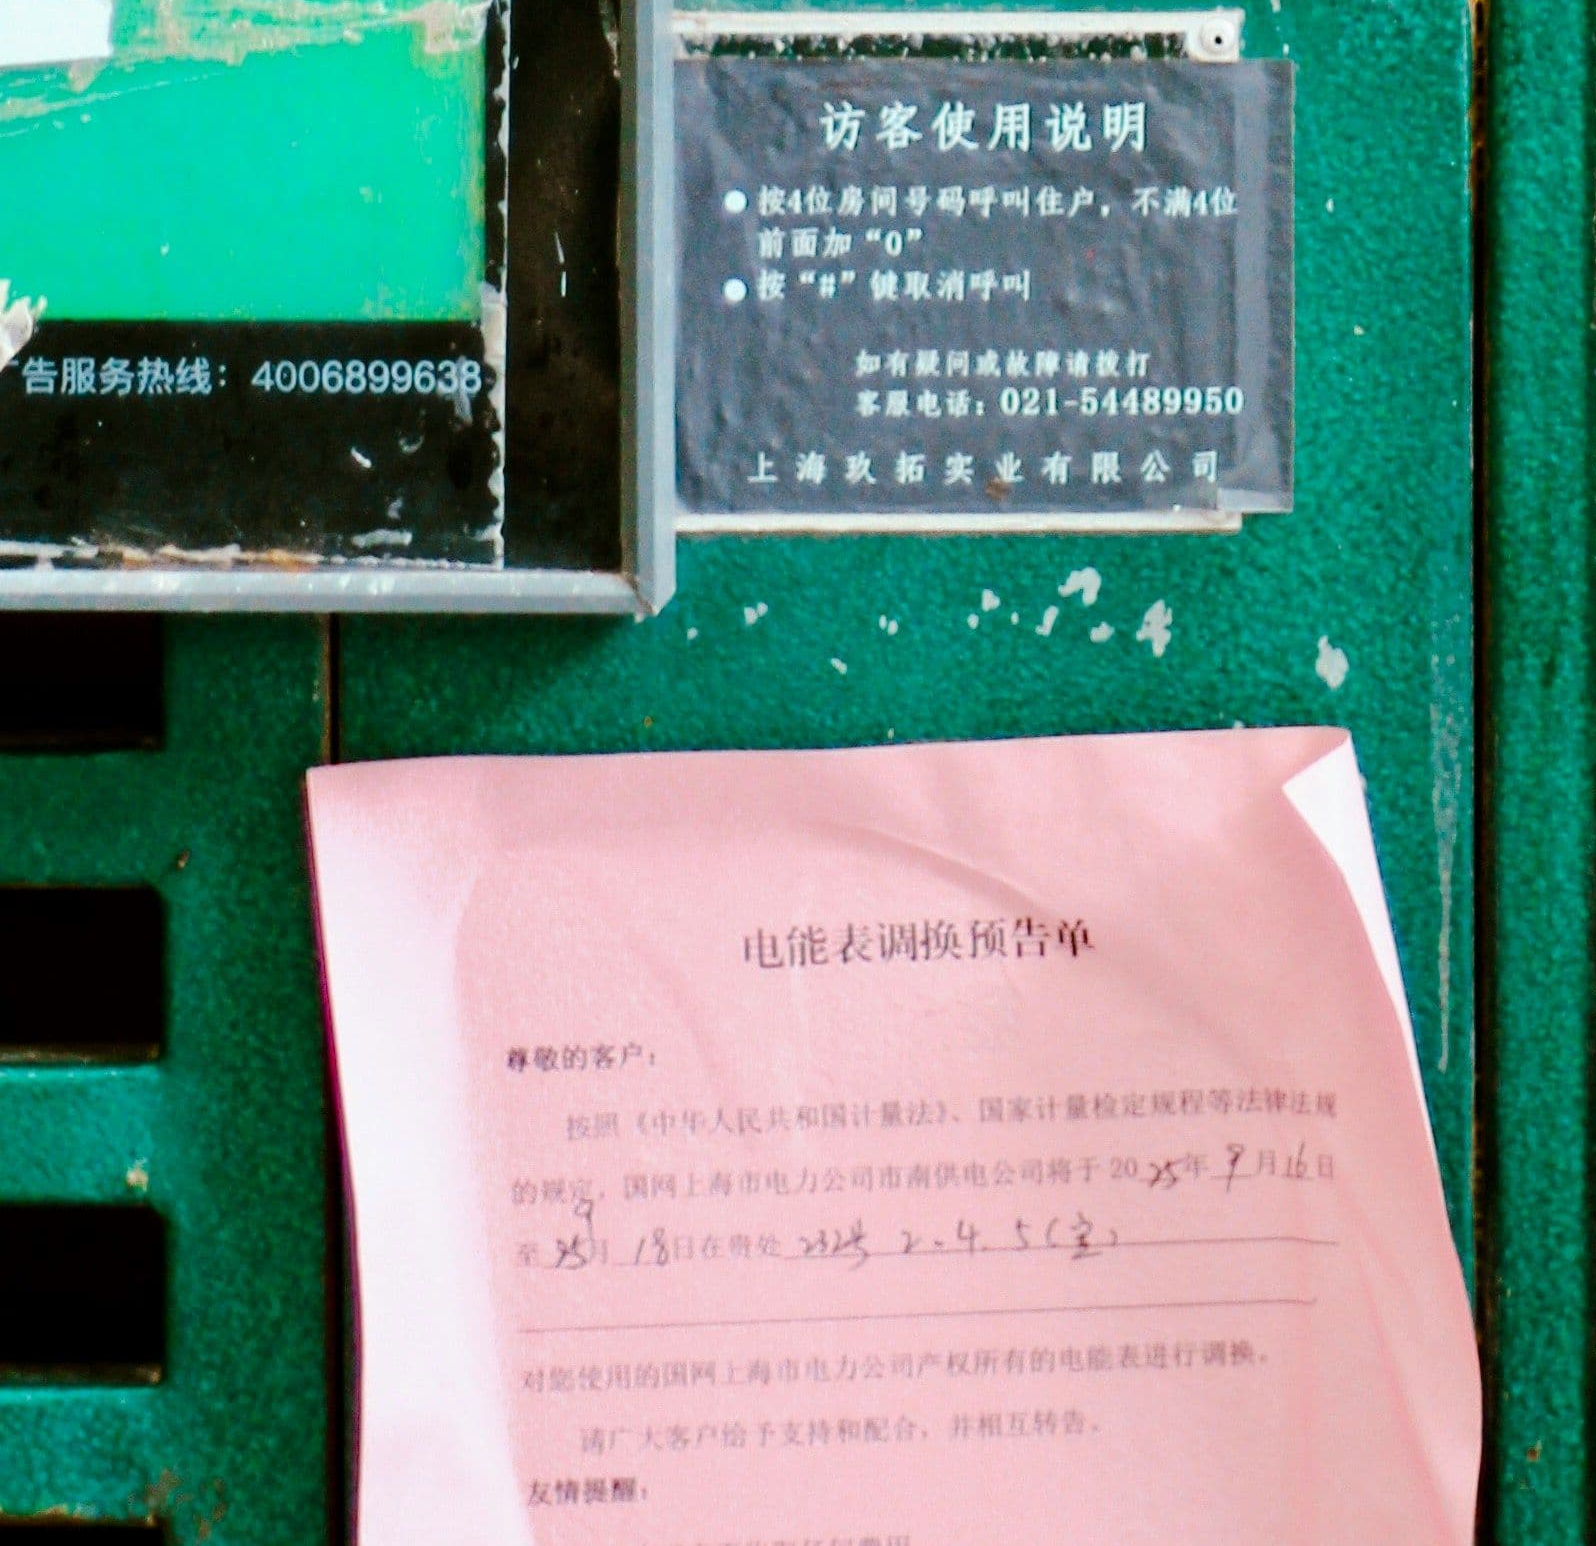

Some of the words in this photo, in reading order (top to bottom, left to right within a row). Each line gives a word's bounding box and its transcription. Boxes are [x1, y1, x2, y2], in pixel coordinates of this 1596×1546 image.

[819, 100, 1148, 154] 访客使用说明
[756, 185, 1238, 219] 按4位房间号码呼叫住户，不满4位
[756, 225, 925, 260] 前面加“0”
[756, 268, 1032, 303] 按“#”键取消呼叫
[854, 349, 1151, 379] 如有疑问或故障请拨打
[747, 450, 1220, 486] 上海玖拓实业有限公司
[740, 914, 1096, 971] 电能表调换预告单
[506, 1041, 657, 1074] 尊敬的客户：
[528, 1476, 649, 1507] 友情提醒：
